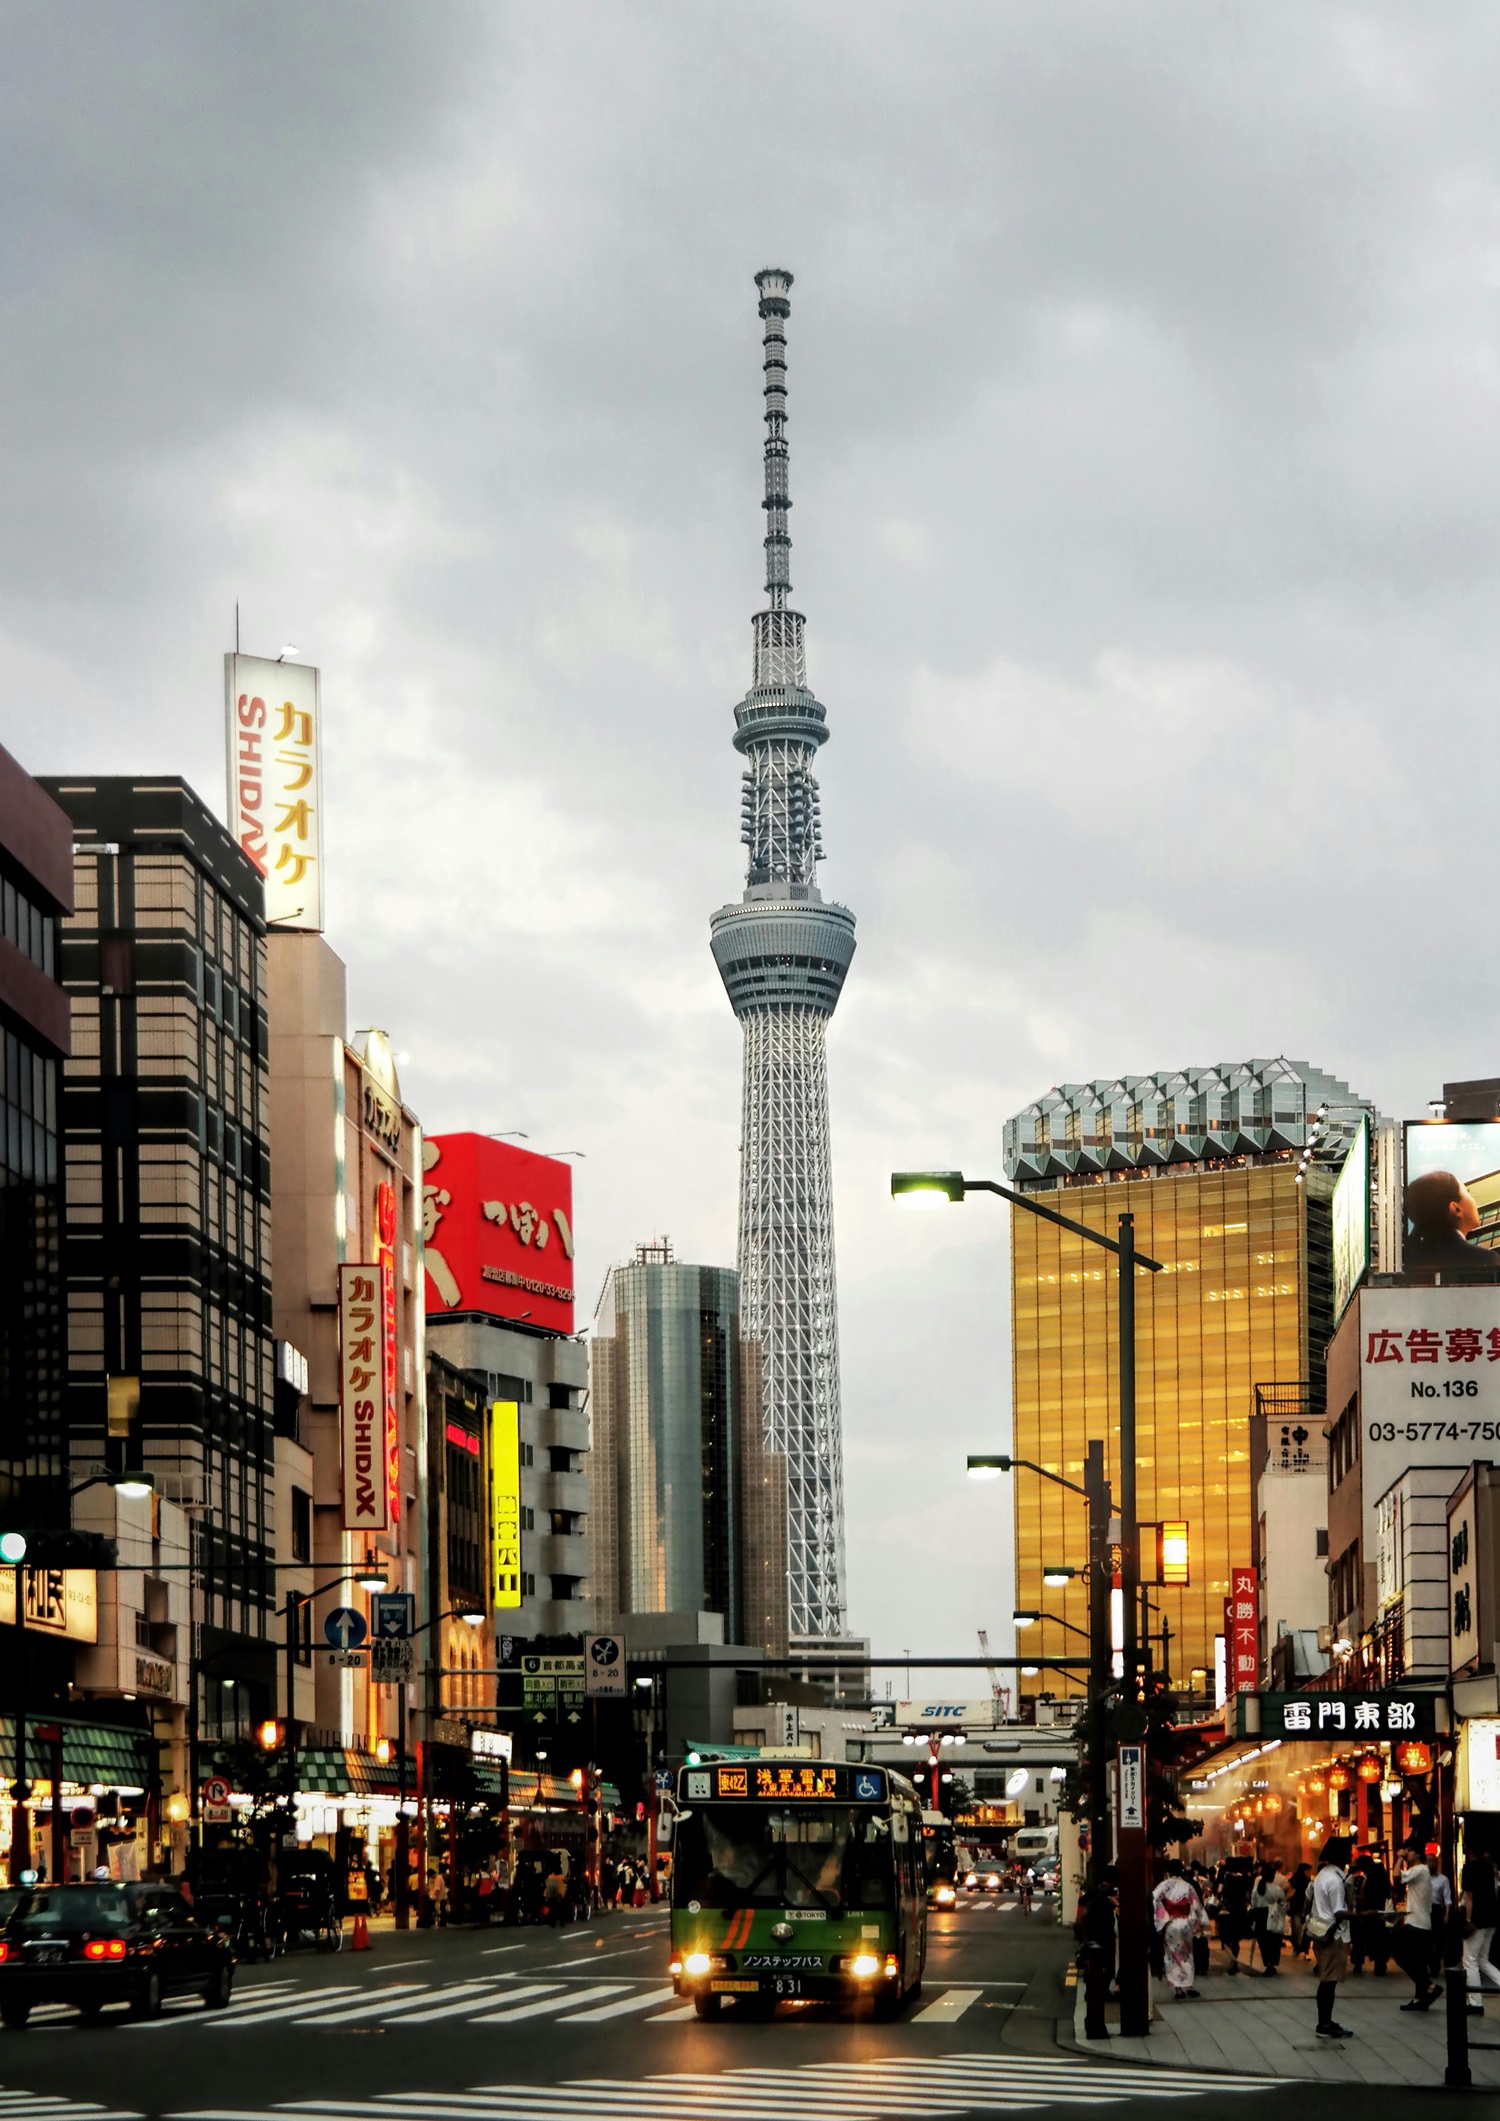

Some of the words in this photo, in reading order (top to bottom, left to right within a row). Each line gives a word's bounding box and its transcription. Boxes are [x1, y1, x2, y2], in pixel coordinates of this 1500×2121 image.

[273, 700, 316, 885] カラオケ
[483, 1200, 574, 1259] つぼ八
[348, 1275, 376, 1393] カラオケ
[1411, 1380, 1478, 1398] No.136
[354, 1399, 377, 1518] SHIDAX
[1236, 1576, 1255, 1692] 丸勝不動産
[529, 1660, 536, 1669] 6
[543, 1660, 584, 1671] 首都高速
[921, 1706, 967, 1717] SITC
[1283, 1701, 1415, 1730] 雷門東部
[756, 1768, 837, 1785] 浅草雷門
[743, 1956, 823, 1967] ノンステップバス
